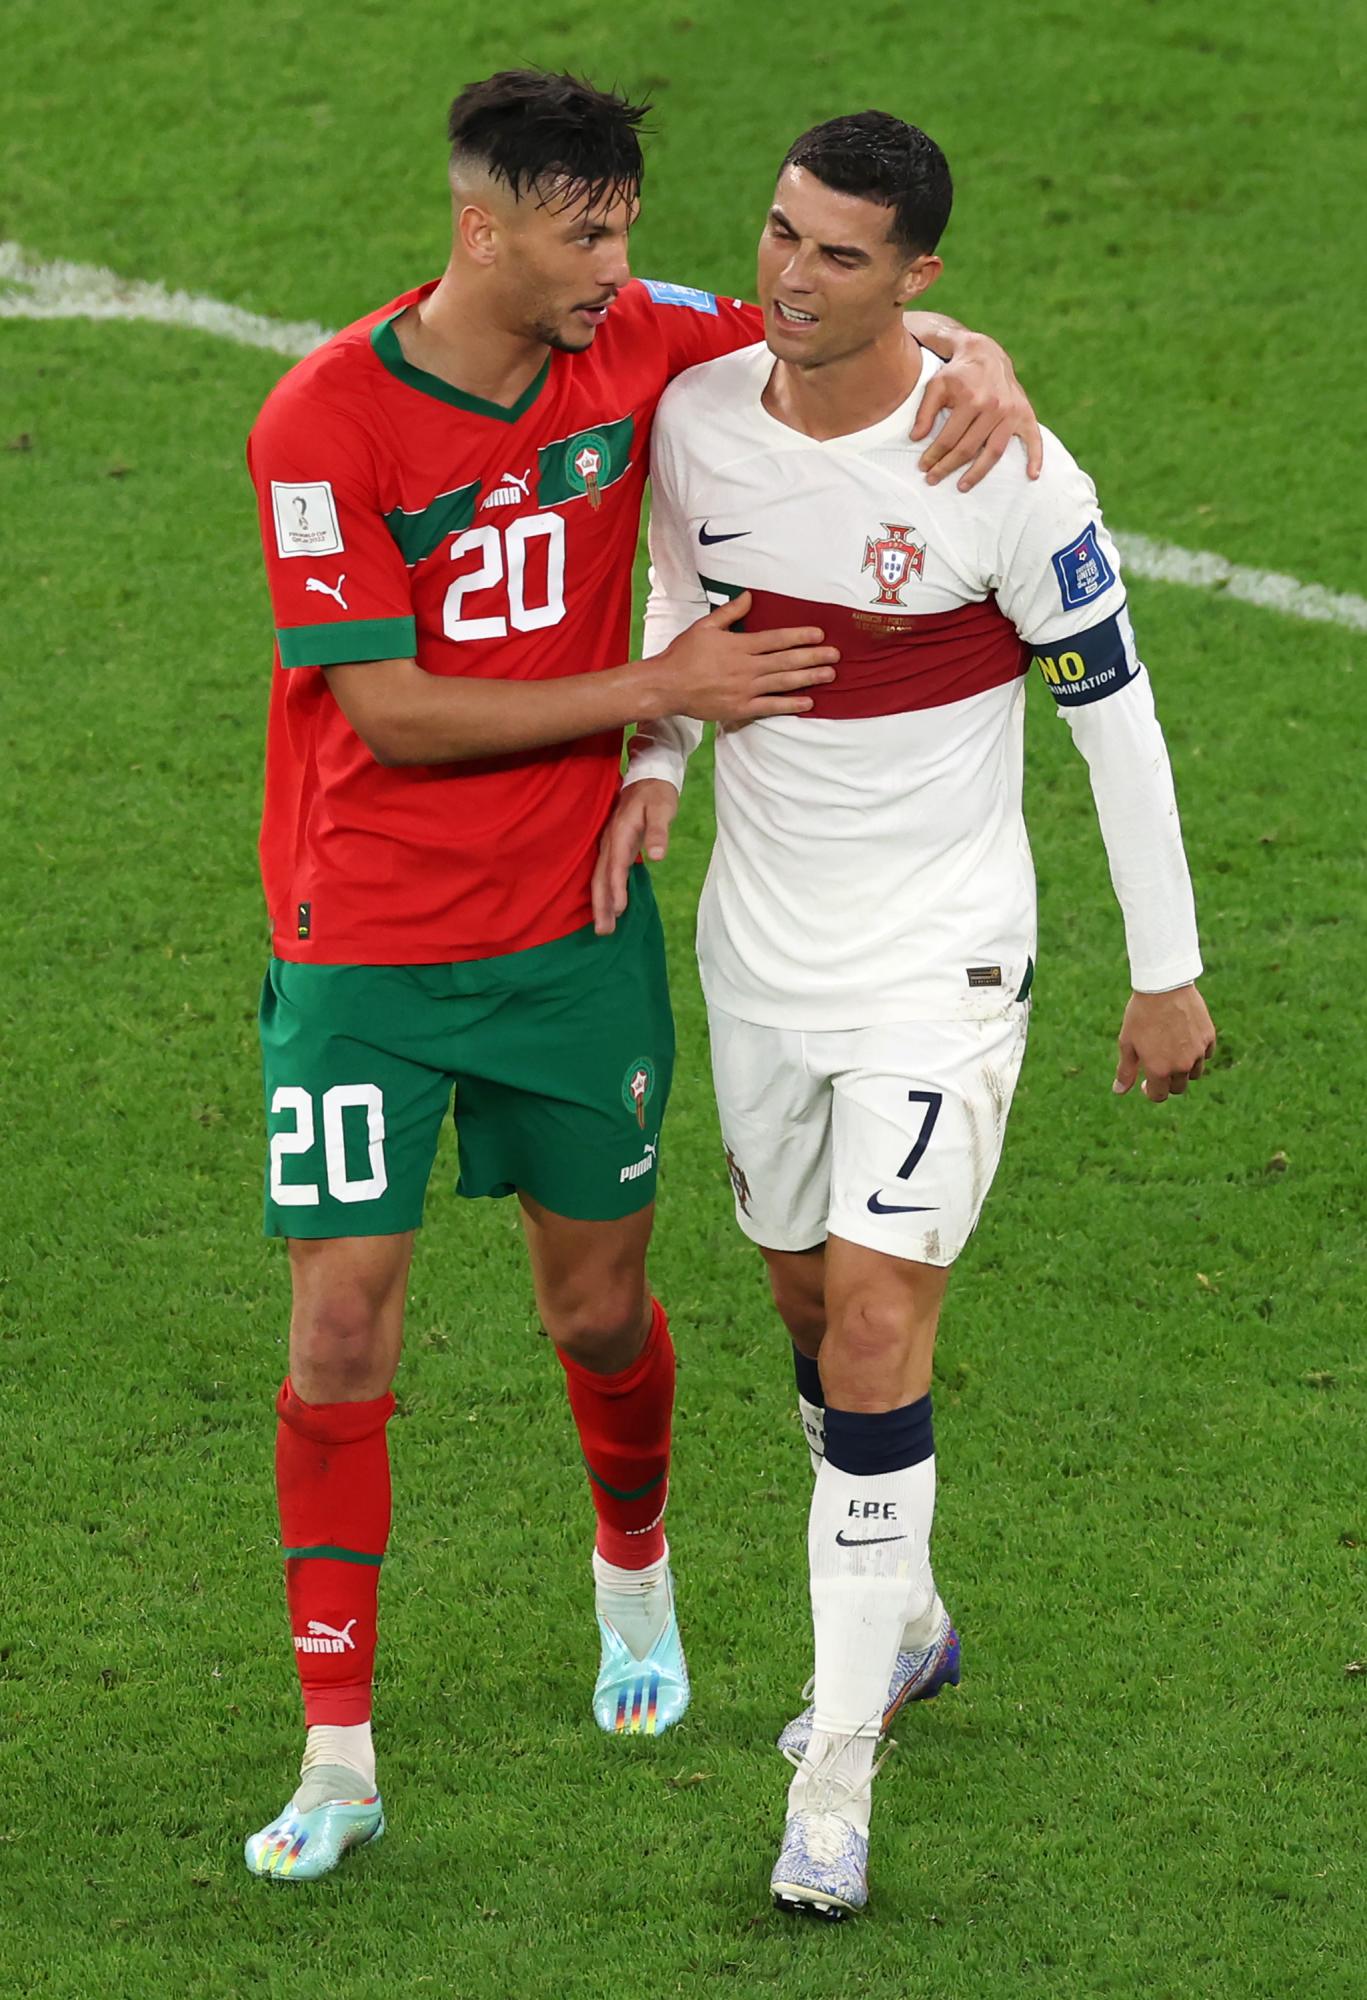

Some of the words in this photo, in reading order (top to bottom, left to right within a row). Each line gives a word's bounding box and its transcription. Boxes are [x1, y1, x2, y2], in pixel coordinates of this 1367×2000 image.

[443, 511, 566, 642] 20
[1036, 651, 1085, 685] NO
[270, 1083, 388, 1206] 20
[896, 1090, 943, 1180] 7
[620, 1153, 652, 1183] PUMA
[294, 1637, 345, 1653] PUMA
